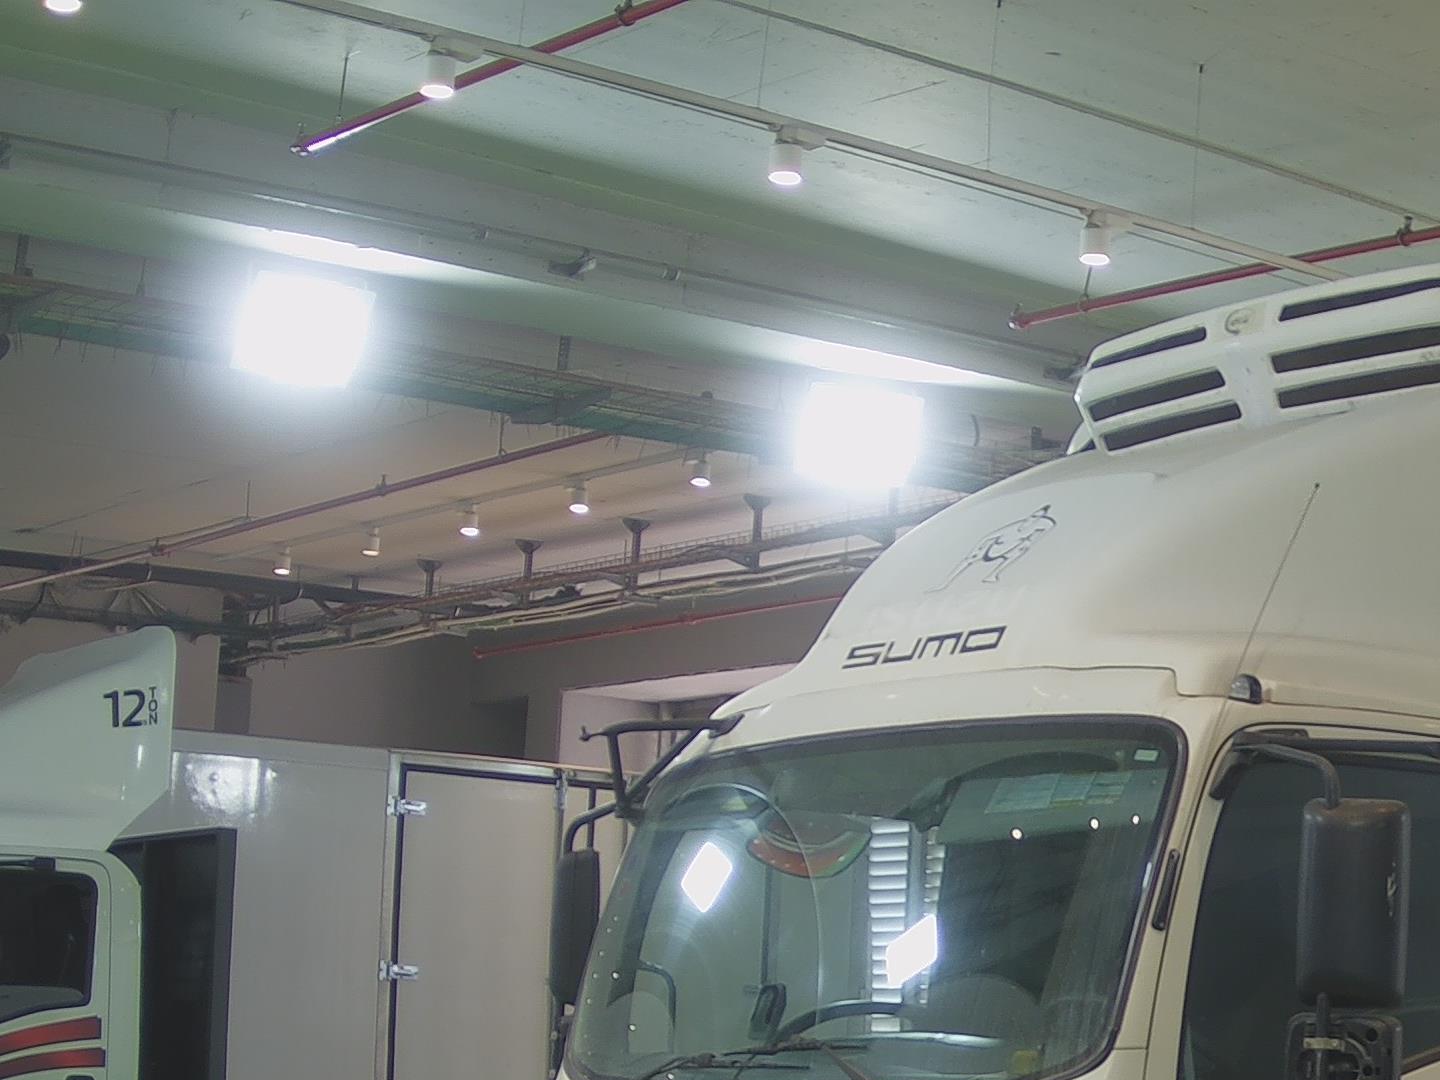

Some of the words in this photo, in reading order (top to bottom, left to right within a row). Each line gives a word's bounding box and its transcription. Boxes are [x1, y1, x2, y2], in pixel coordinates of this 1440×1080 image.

[841, 625, 1007, 670] SUMO
[103, 689, 146, 728] 12
[148, 685, 158, 726] TON
